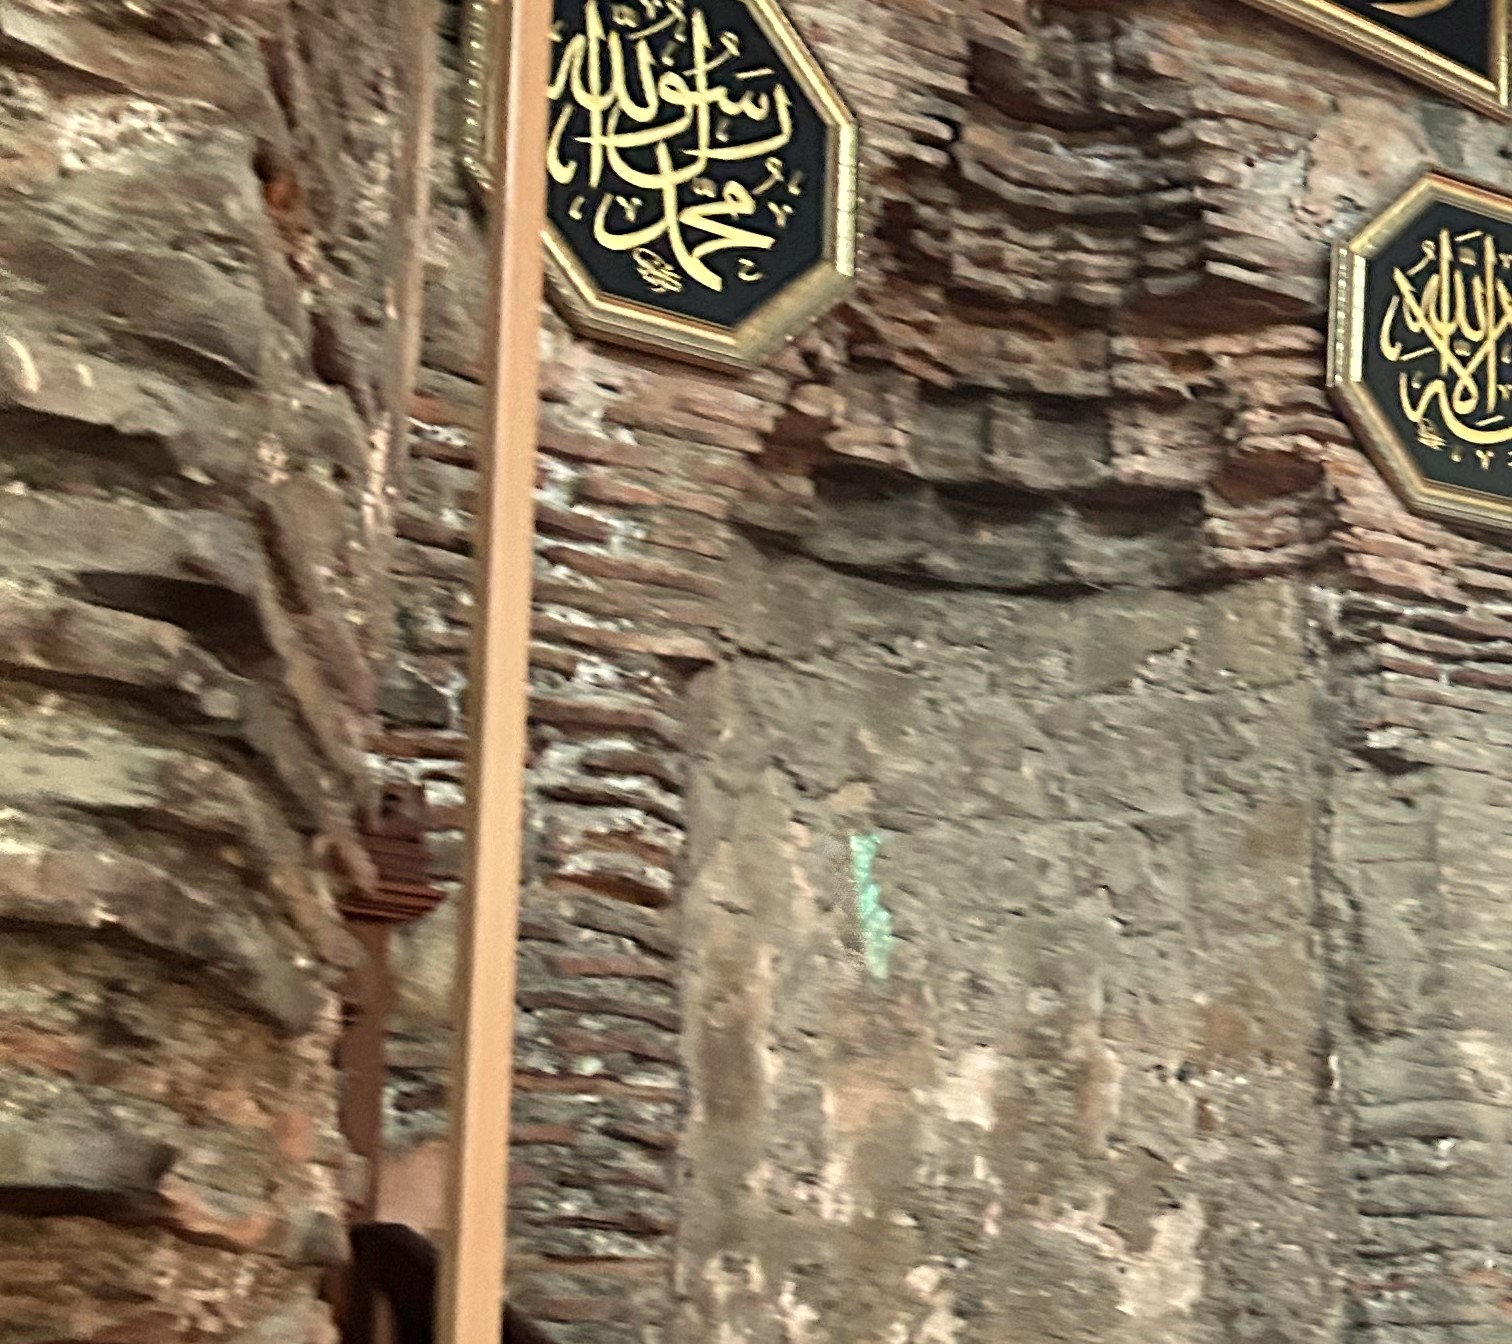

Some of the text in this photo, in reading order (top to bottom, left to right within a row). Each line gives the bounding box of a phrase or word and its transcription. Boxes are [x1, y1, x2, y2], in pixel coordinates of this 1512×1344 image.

[572, 8, 793, 190] رسول
[594, 142, 777, 293] محمد
[1400, 227, 1487, 377] الله
